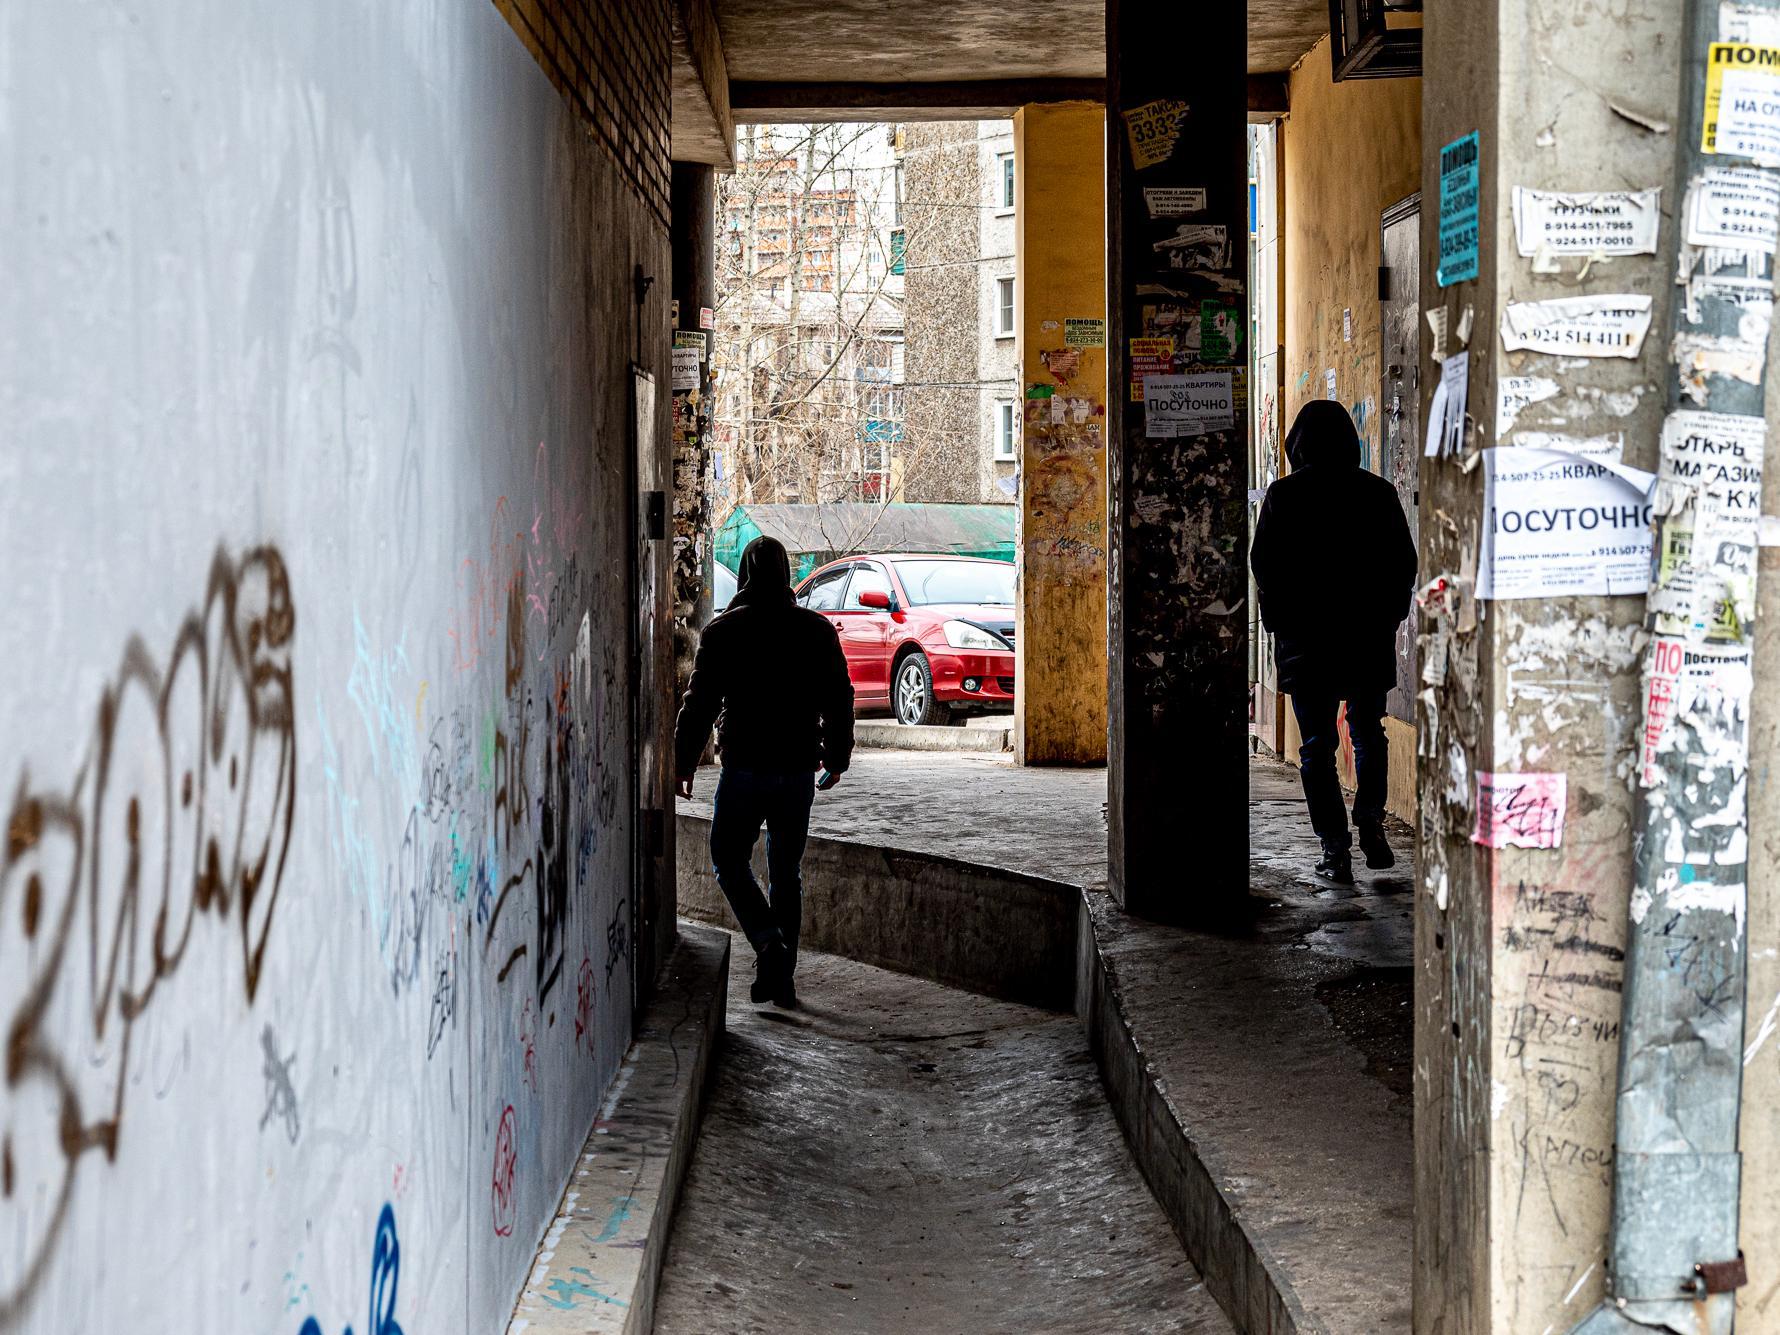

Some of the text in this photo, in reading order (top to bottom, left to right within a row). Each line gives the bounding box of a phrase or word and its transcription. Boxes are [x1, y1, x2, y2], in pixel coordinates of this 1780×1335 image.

[1553, 205, 1621, 215] ГРУЗЧКИ
[677, 332, 705, 340] ПОМОЩЬ
[1185, 381, 1226, 389] КВАРТИРЫ
[1149, 398, 1228, 411] ПОСУТОЧНО
